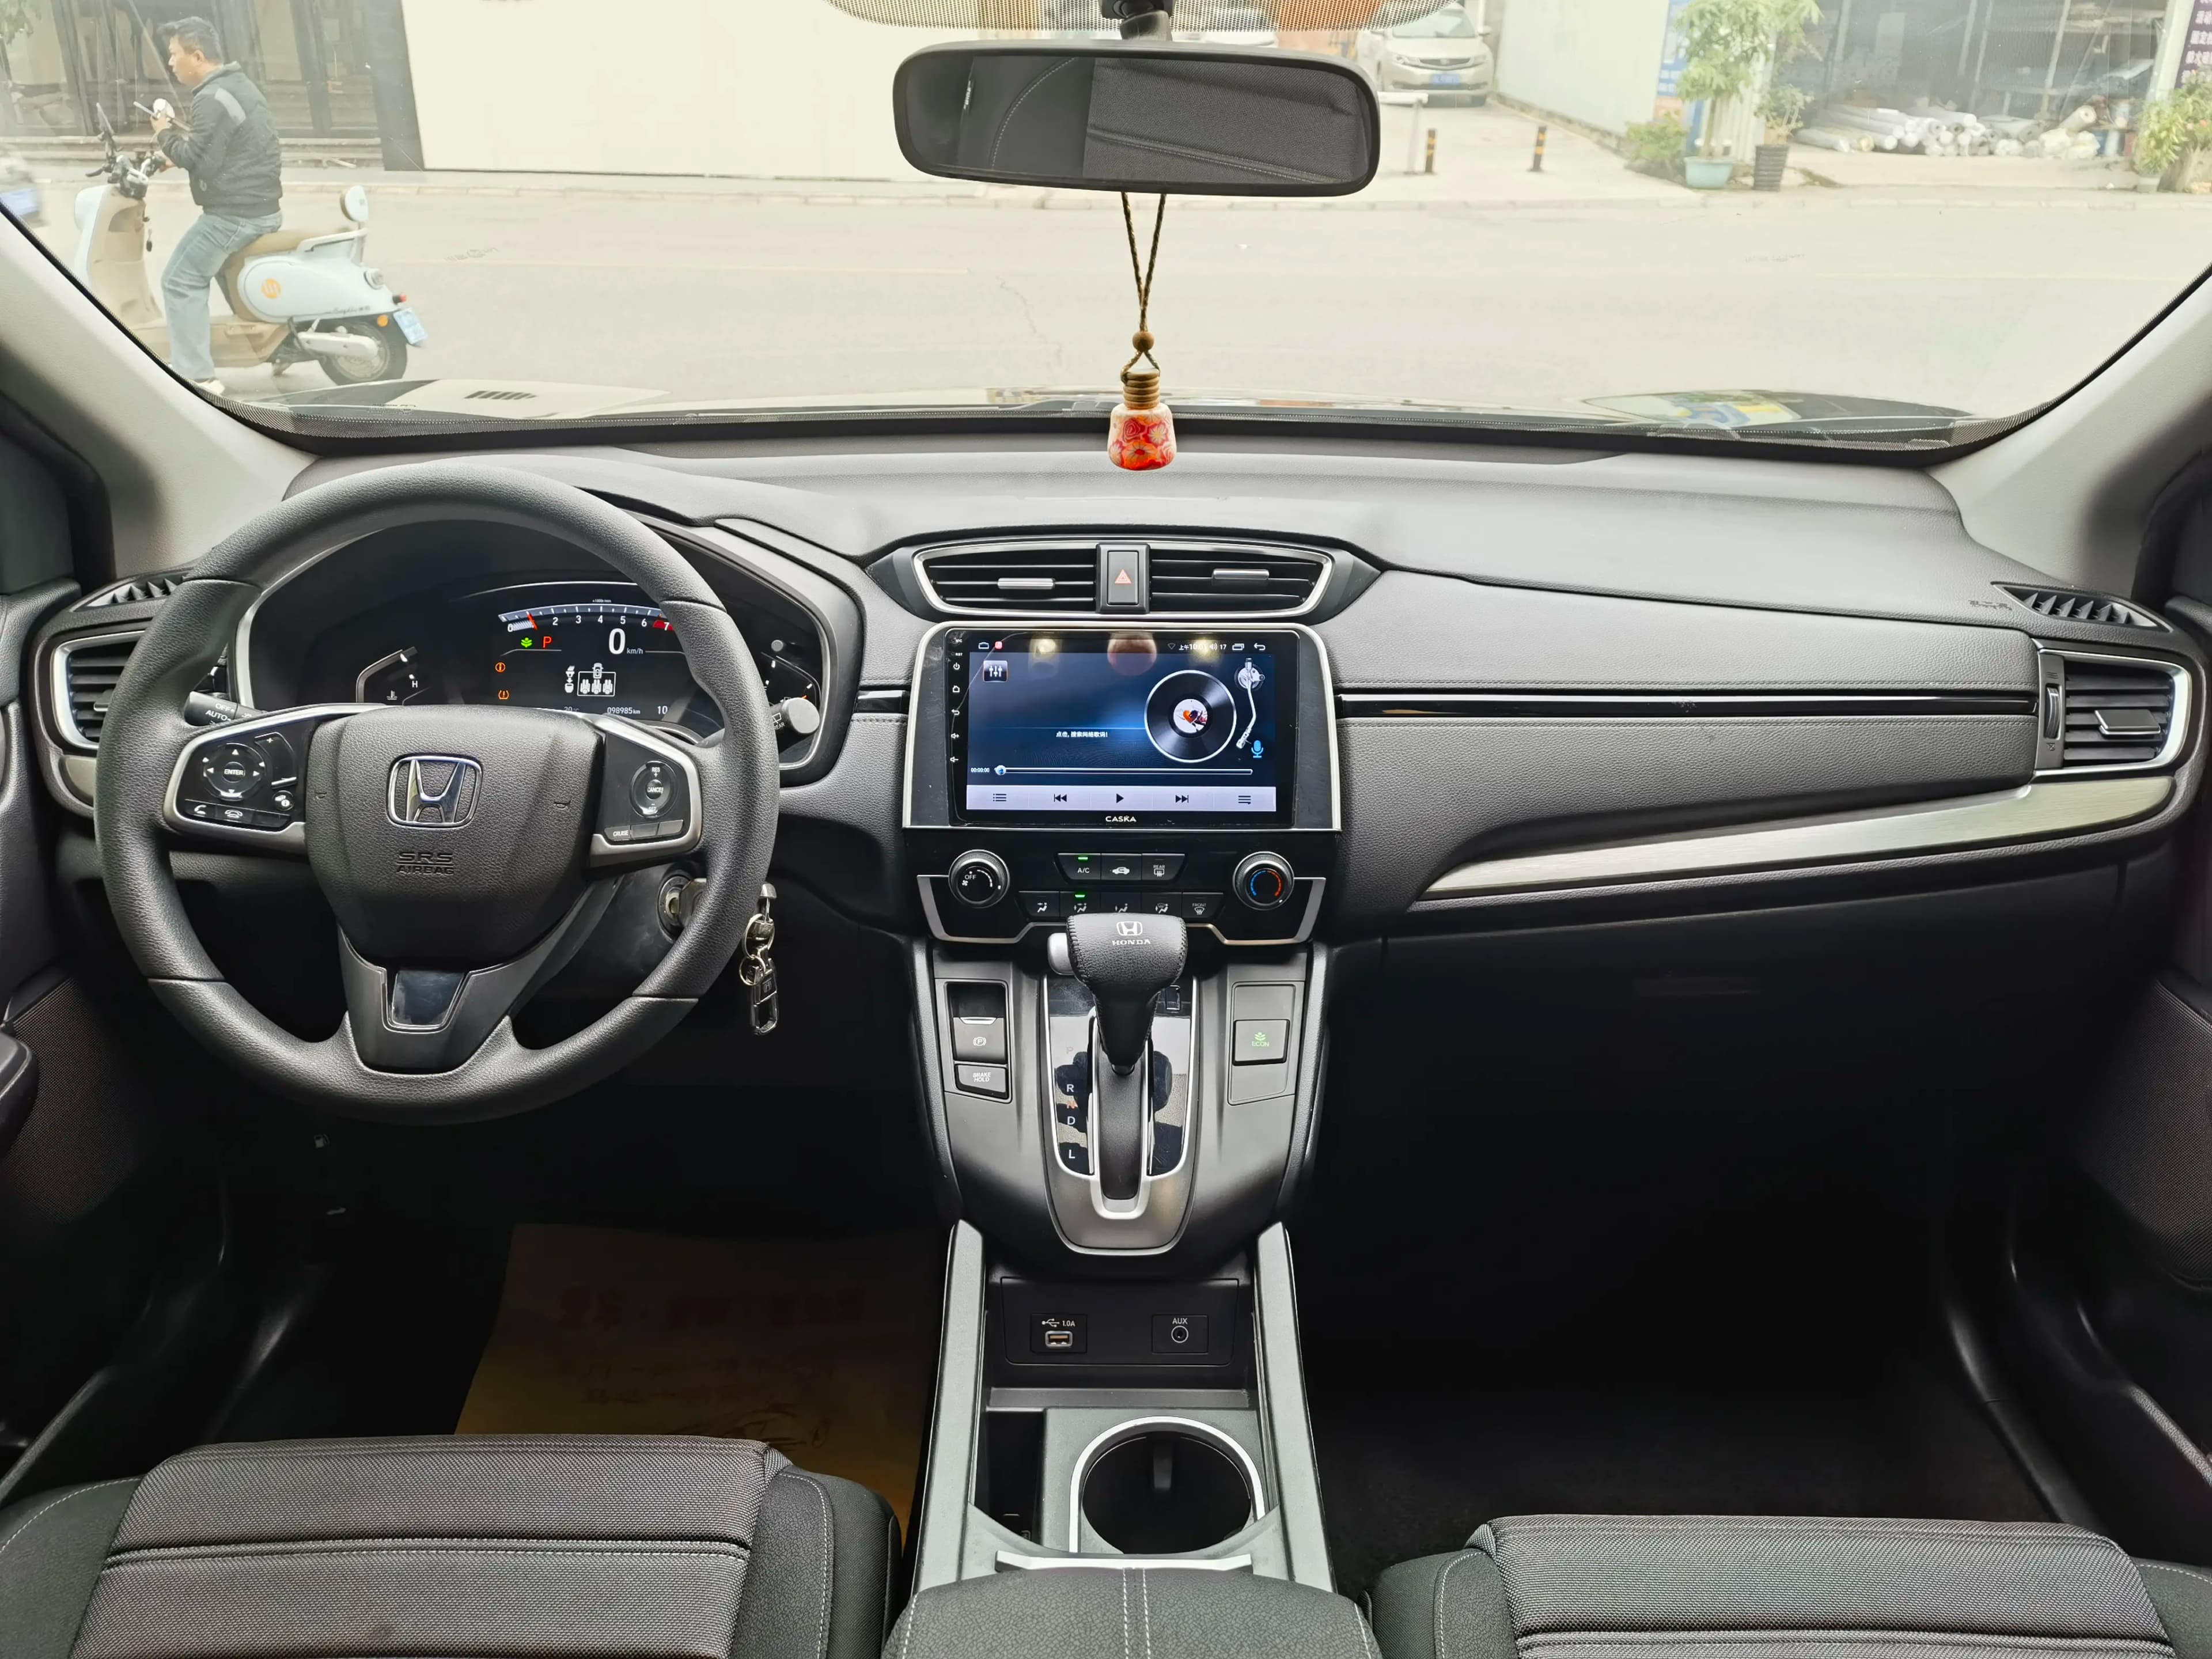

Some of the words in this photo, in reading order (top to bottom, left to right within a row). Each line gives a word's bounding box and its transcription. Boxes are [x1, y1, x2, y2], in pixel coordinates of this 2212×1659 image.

[552, 617, 558, 626] 2
[575, 615, 581, 624] 3
[597, 615, 603, 623] 4
[620, 616, 626, 624] 5
[641, 618, 647, 627] 6
[664, 622, 669, 631] 7
[543, 636, 552, 648] P
[609, 628, 626, 654] 0
[215, 703, 231, 711] OFF
[657, 706, 668, 715] 10
[205, 710, 228, 721] AUTO
[397, 853, 453, 863] SRS
[396, 865, 454, 875] AIRBAG
[1066, 1084, 1074, 1092] R
[1067, 1116, 1075, 1125] D
[1069, 1149, 1075, 1159] L
